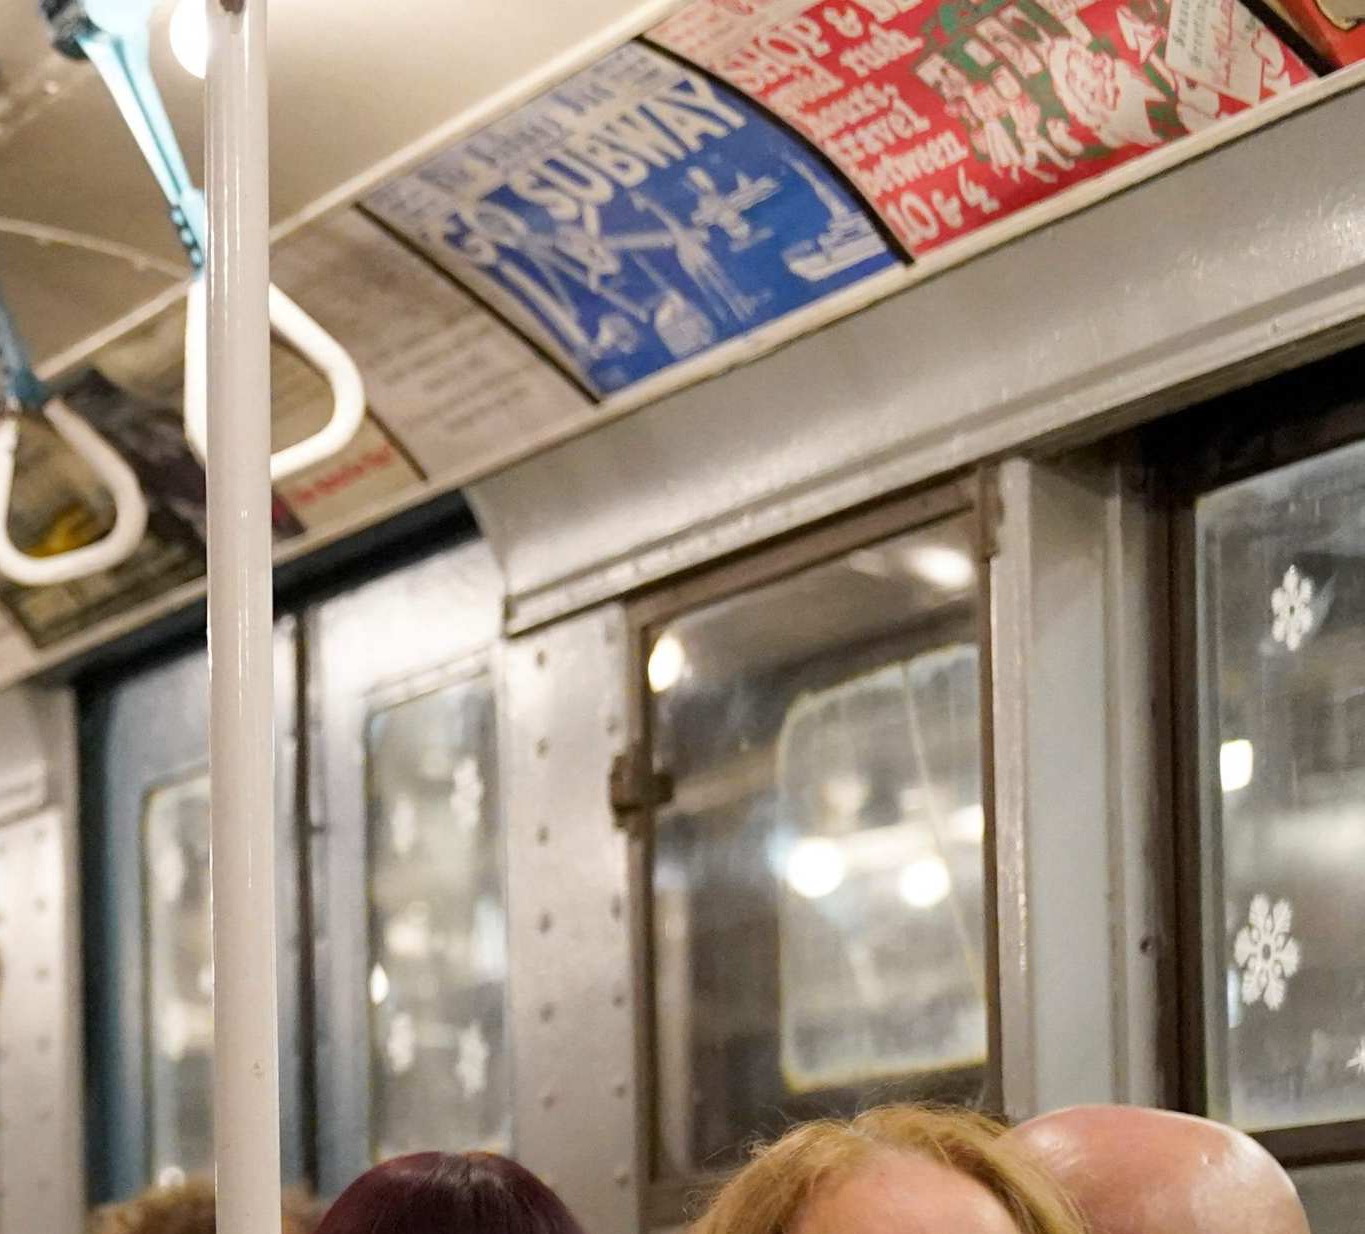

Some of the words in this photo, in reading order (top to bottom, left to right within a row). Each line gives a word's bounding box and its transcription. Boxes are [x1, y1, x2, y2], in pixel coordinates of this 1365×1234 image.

[727, 17, 831, 93] SHOP
[509, 77, 747, 221] SUBWAY
[822, 97, 931, 163] travel
[864, 130, 969, 198] between
[885, 190, 940, 243] 10
[958, 163, 999, 214] 4
